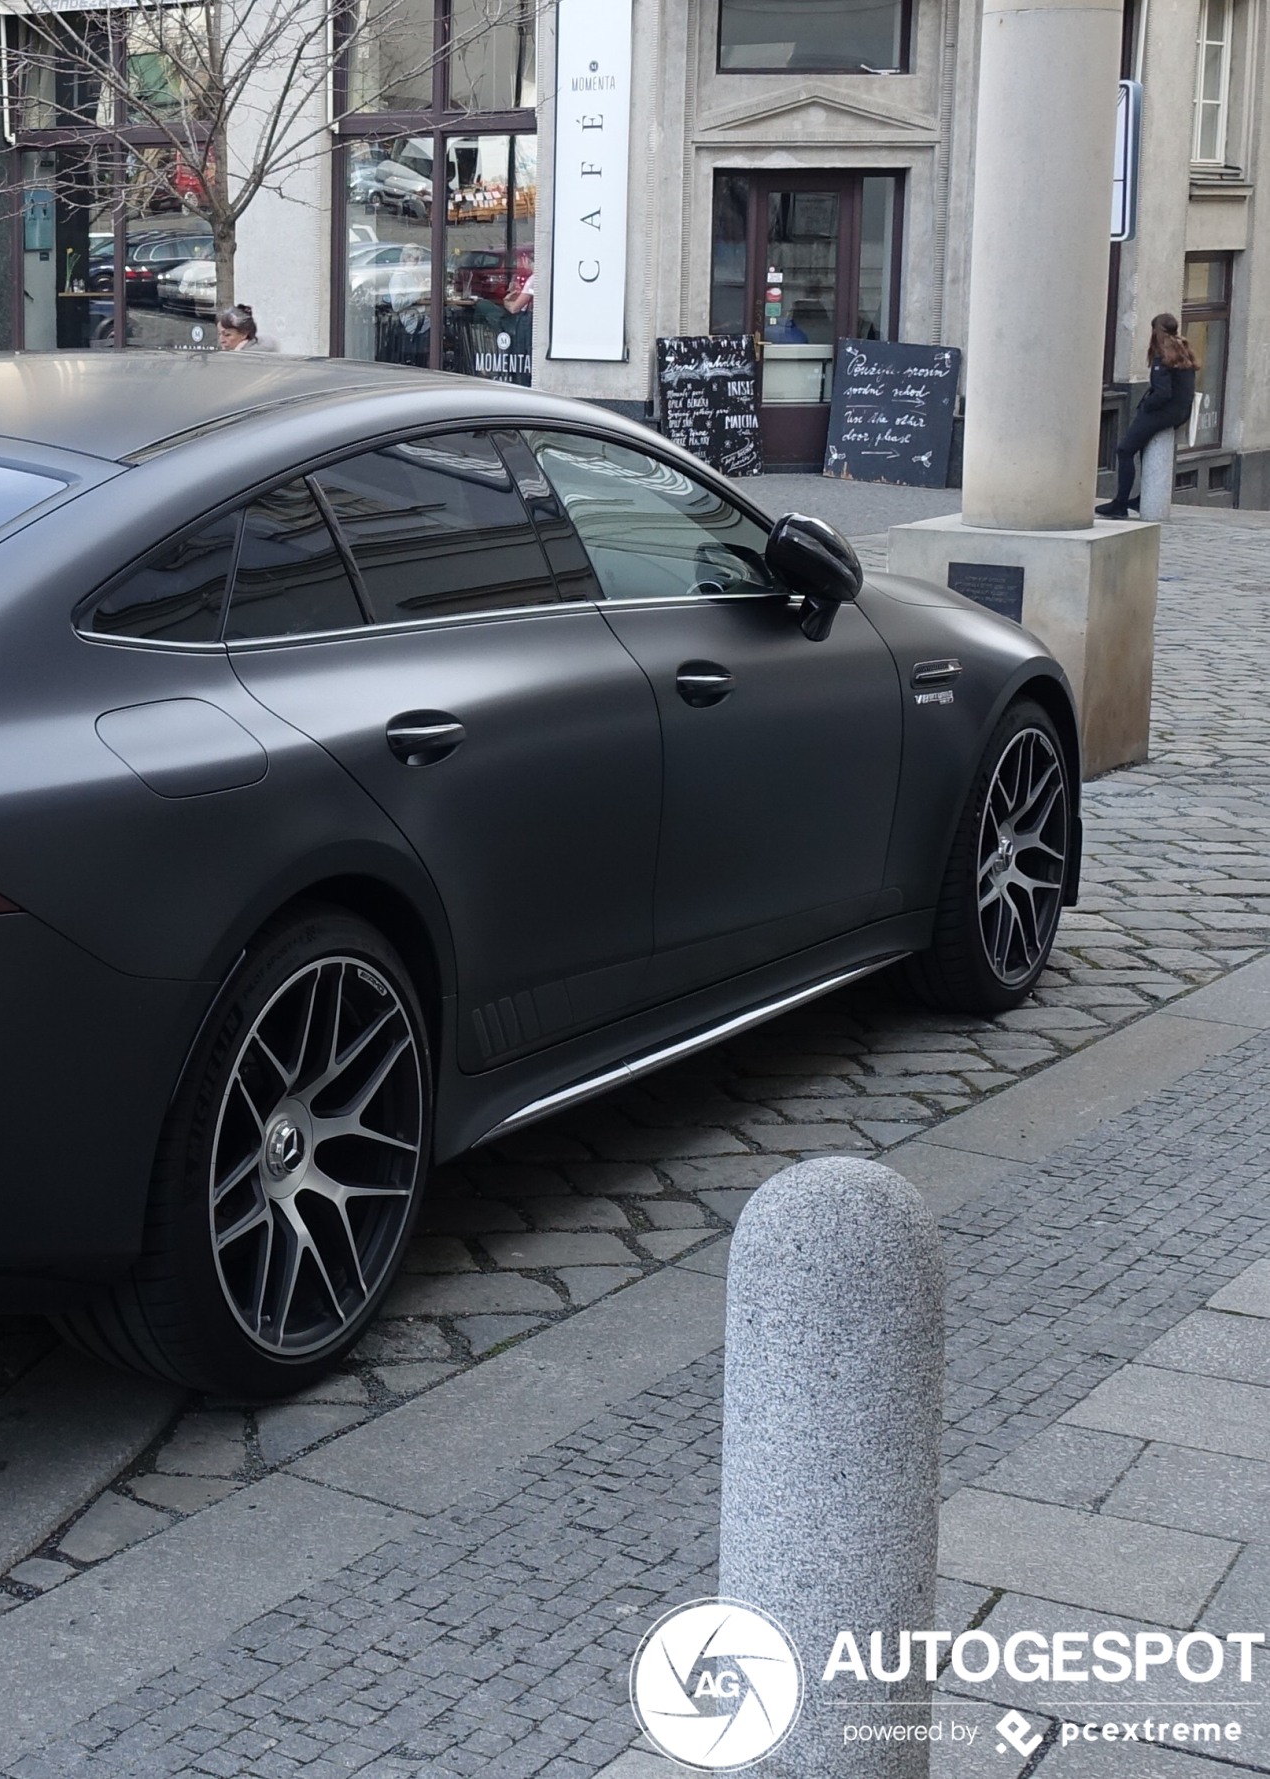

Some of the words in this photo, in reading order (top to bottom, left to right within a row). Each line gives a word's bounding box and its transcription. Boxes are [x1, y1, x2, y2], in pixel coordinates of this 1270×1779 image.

[571, 76, 616, 91] MOMENTA
[576, 113, 604, 284] CAFÉ
[475, 352, 531, 374] MOMENTA
[724, 414, 759, 430] MATCHA
